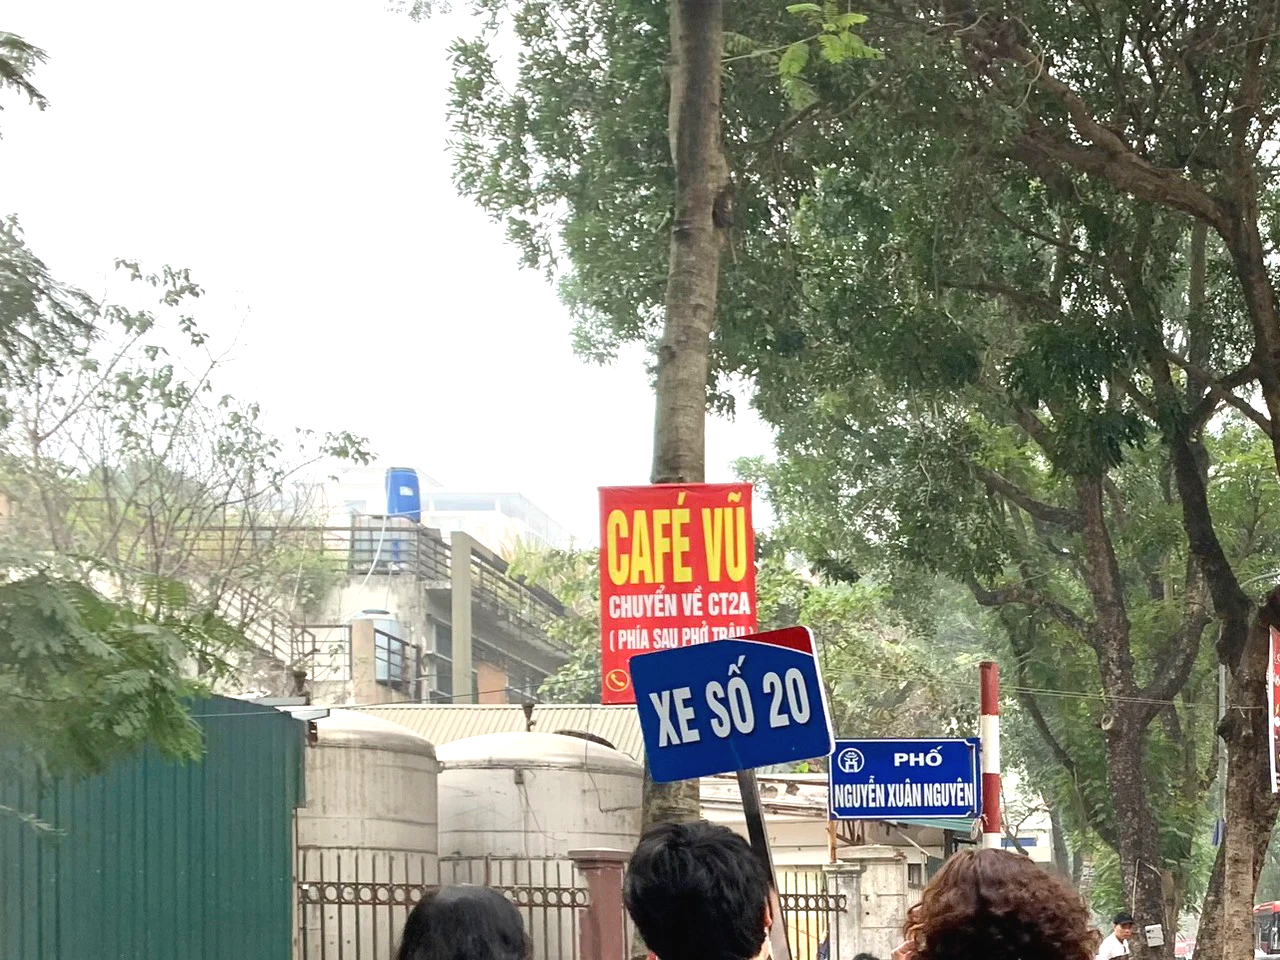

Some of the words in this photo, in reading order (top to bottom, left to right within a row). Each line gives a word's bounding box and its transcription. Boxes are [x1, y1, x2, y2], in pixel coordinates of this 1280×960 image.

[606, 491, 693, 586] CAFÉ
[701, 491, 747, 583] VŨ
[608, 585, 678, 619] CHUYỂN
[681, 585, 703, 617] VỀ
[708, 591, 751, 616] CT2A
[618, 625, 650, 650] PHÍA
[653, 627, 678, 649] SAU
[681, 620, 709, 647] PHỞ
[648, 686, 701, 748] XE
[705, 654, 755, 739] SỐ
[762, 667, 811, 729] 20
[893, 745, 943, 767] PHỐ
[834, 775, 885, 808] NGUYỄN
[887, 778, 922, 808] XUÂN
[923, 777, 974, 807] NGUYÊN
